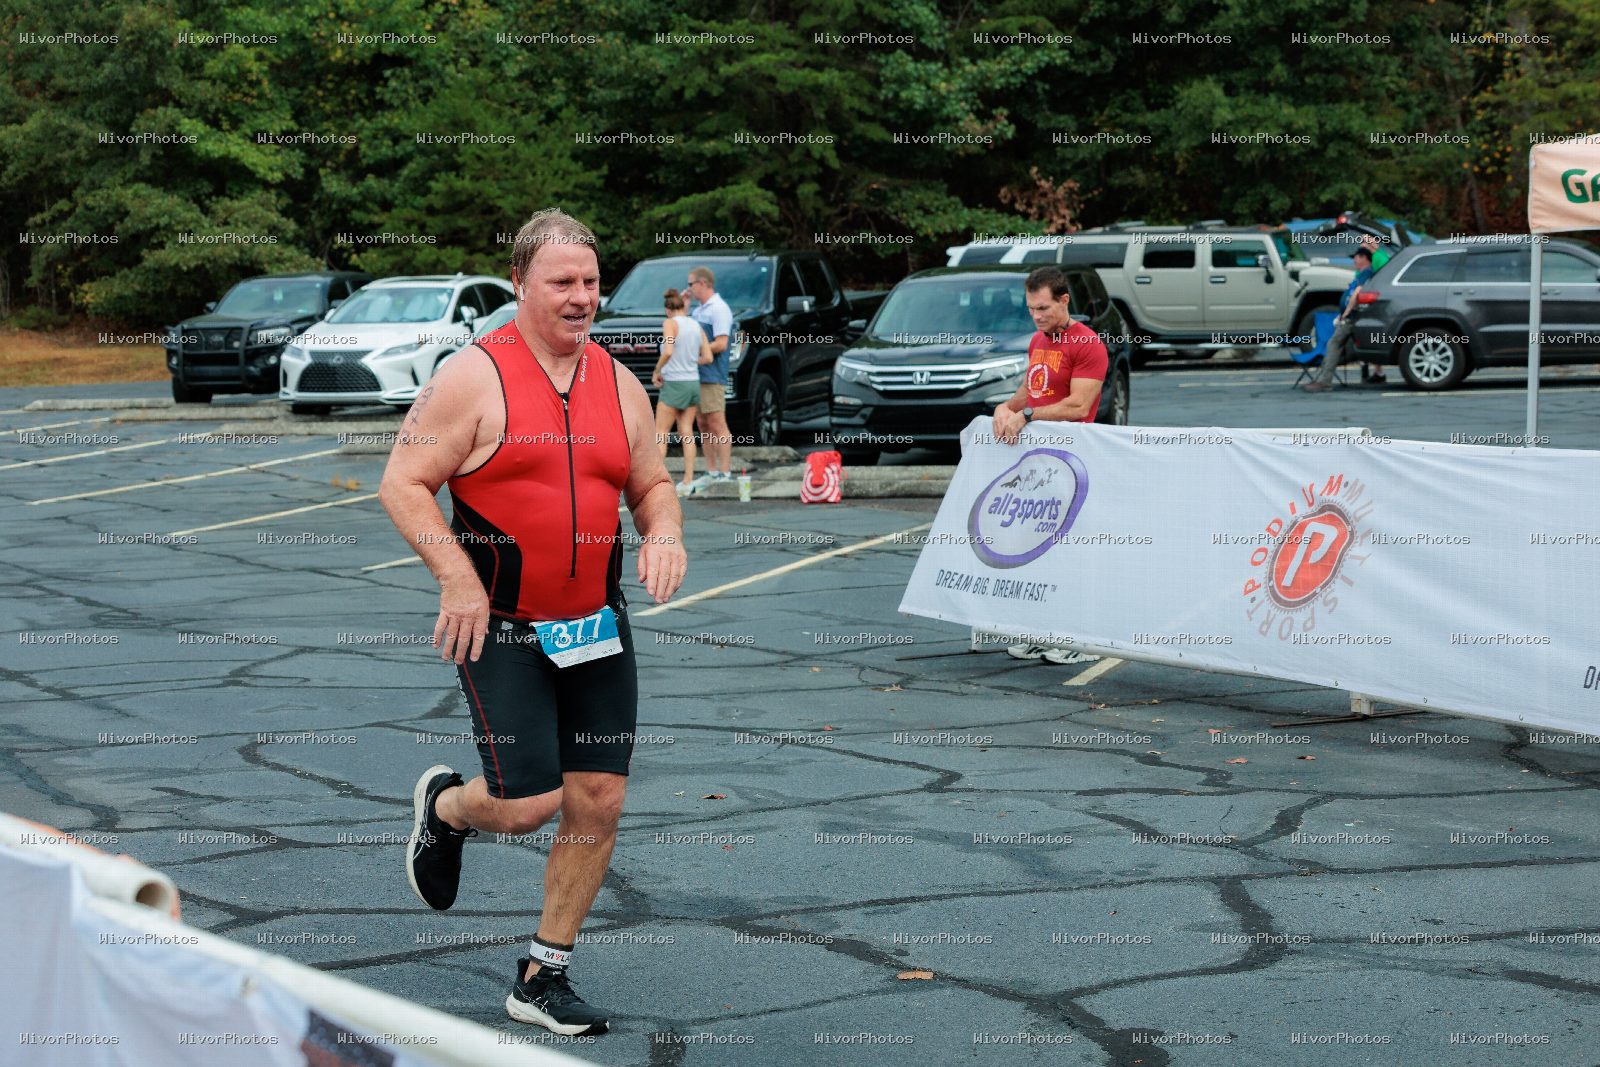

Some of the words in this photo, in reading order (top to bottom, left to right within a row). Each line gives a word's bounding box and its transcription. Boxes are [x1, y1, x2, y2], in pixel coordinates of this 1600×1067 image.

[608, 343, 658, 353] GMC
[987, 493, 1062, 528] all3sports
[1034, 521, 1058, 533] .com
[1242, 473, 1344, 596] PODIUM
[935, 569, 974, 593] DREAM
[972, 577, 990, 596] BIG.
[992, 579, 1024, 600] DREAM
[551, 613, 602, 649] 377
